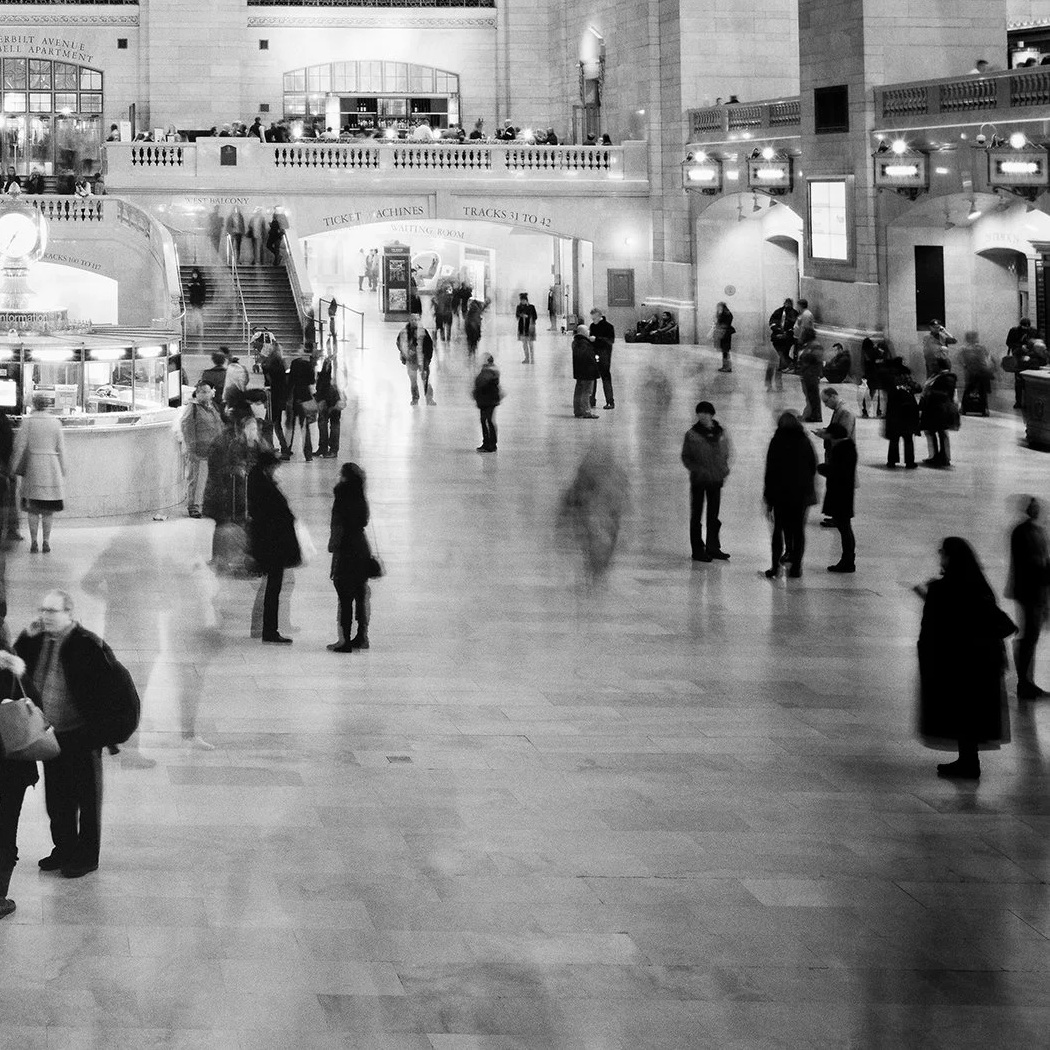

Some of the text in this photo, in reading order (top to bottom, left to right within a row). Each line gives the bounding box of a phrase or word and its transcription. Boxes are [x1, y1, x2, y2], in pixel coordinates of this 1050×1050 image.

[41, 37, 86, 51] AVENUE
[29, 45, 94, 63] APARTMENT
[323, 206, 424, 227] TICKET ACHINES
[462, 206, 552, 228] TRACKS 31 TO 42
[391, 224, 465, 239] WAITING ROOM
[43, 253, 67, 262] RACKS
[80, 259, 92, 268] TO
